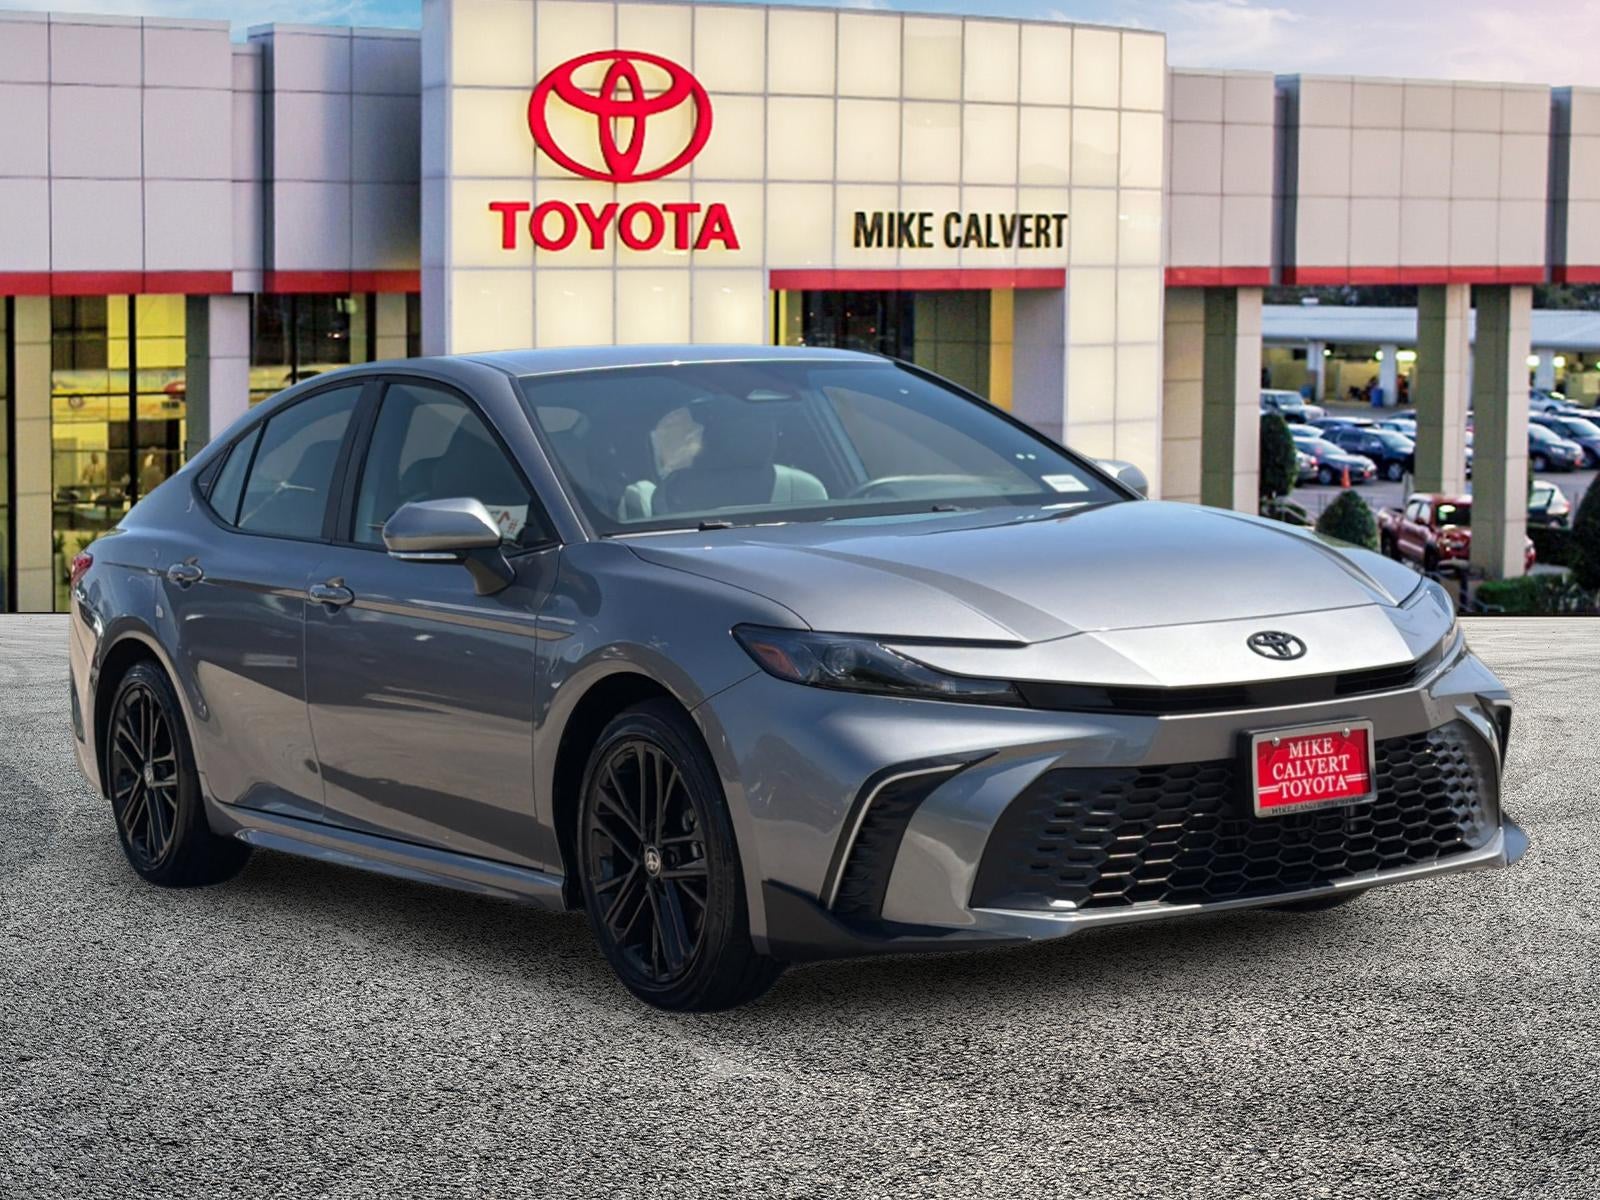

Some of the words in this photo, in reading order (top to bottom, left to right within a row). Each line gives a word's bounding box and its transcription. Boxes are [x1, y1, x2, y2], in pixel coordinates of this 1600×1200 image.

[490, 200, 739, 251] TOYOTA
[854, 211, 933, 248] MIKE
[944, 212, 1068, 249] CALVERT
[1288, 737, 1334, 759] MIKE
[1272, 754, 1350, 780] CALVERT
[1279, 774, 1348, 798] TOYOTA
